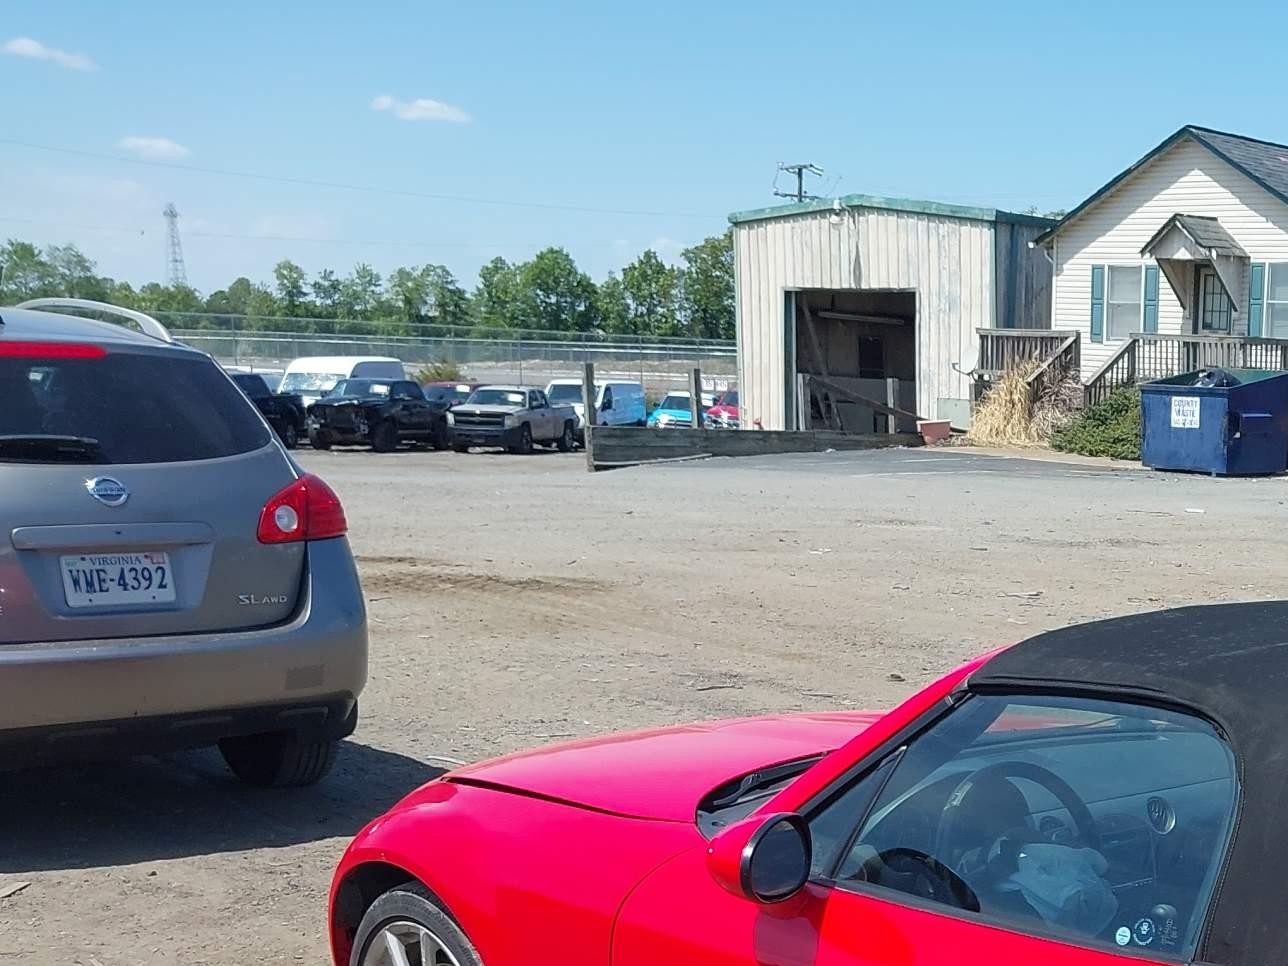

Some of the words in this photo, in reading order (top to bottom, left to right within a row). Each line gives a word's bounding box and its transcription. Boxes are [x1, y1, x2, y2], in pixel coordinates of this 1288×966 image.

[88, 555, 142, 566] VIRGINIA
[68, 566, 168, 594] WME-4392
[239, 594, 260, 605] SL
[262, 595, 288, 604] AWD
